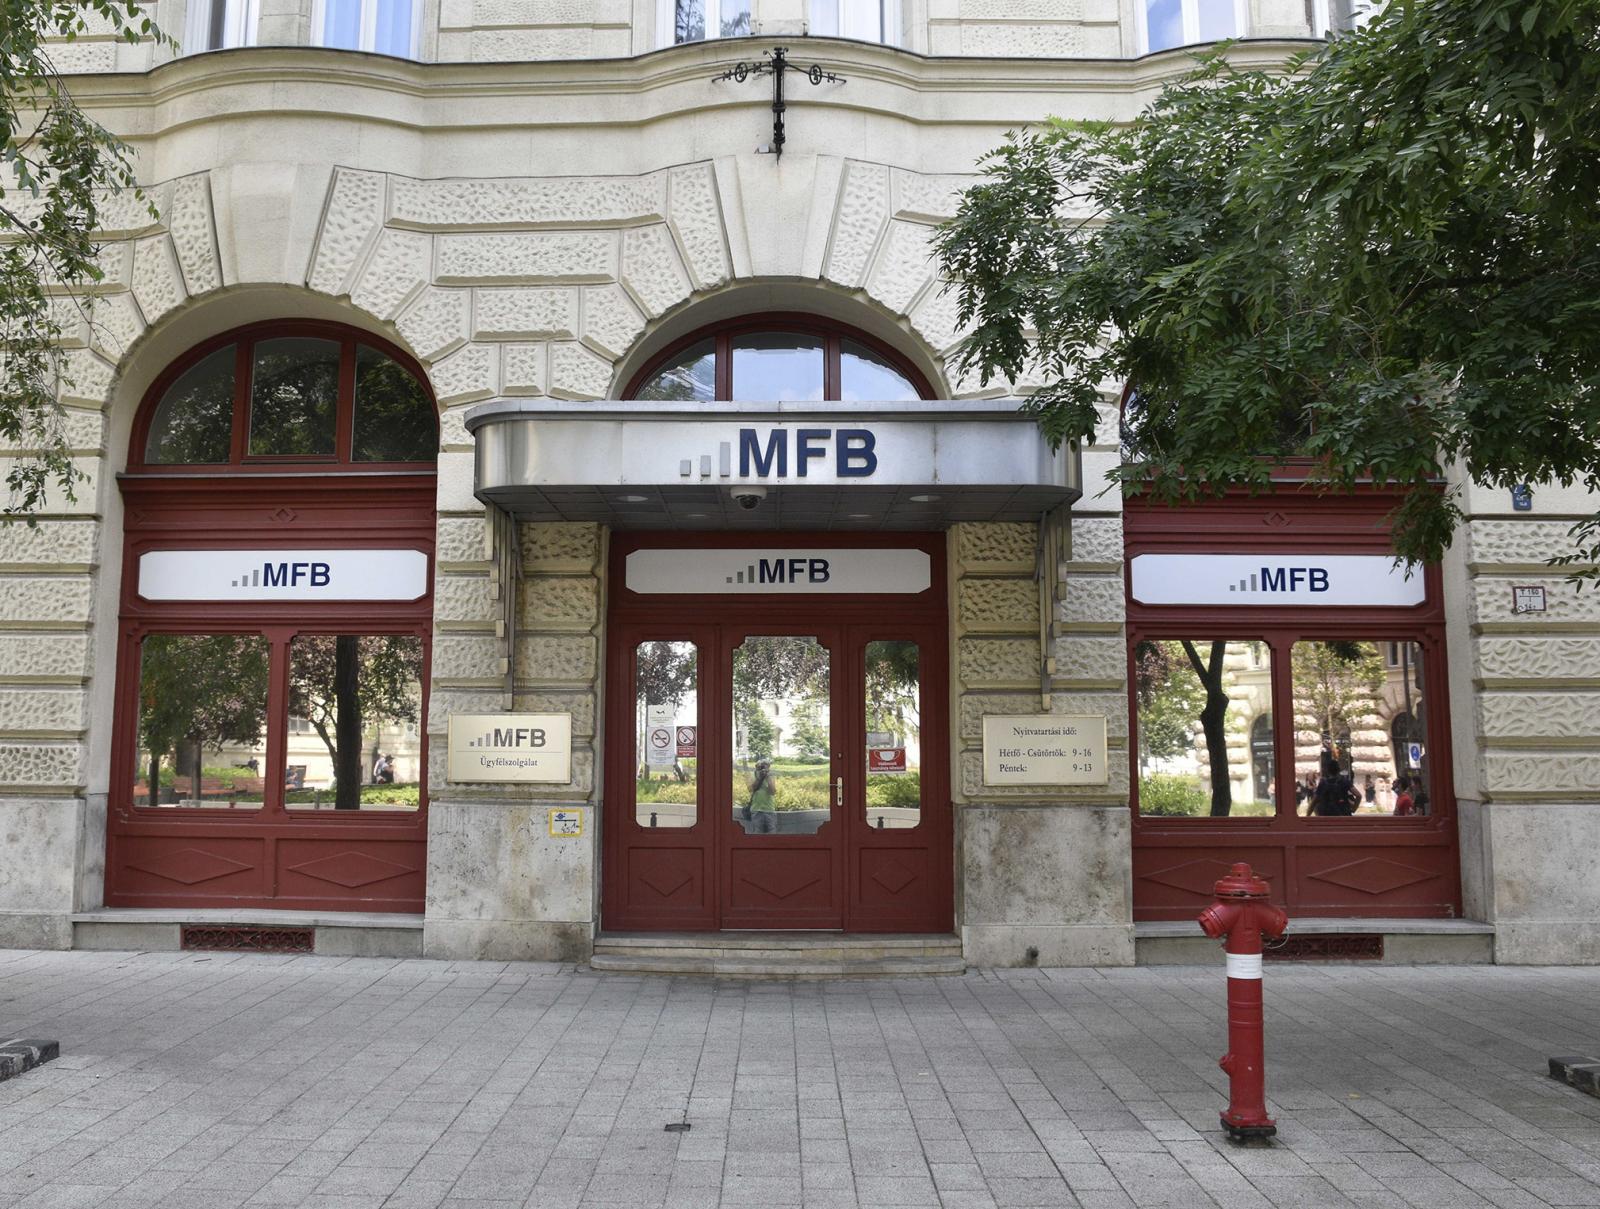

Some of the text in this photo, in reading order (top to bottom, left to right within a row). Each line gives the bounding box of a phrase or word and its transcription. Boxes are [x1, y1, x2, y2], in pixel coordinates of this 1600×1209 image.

[739, 428, 877, 478] MFB
[263, 562, 331, 587] MFB
[759, 558, 831, 584] MFB
[1261, 567, 1330, 592] MFB
[493, 728, 546, 748] MFB
[1013, 727, 1061, 738] Nyitvatartási
[480, 755, 538, 768] Ügyfélszolgálat
[999, 763, 1028, 773] Péntek:
